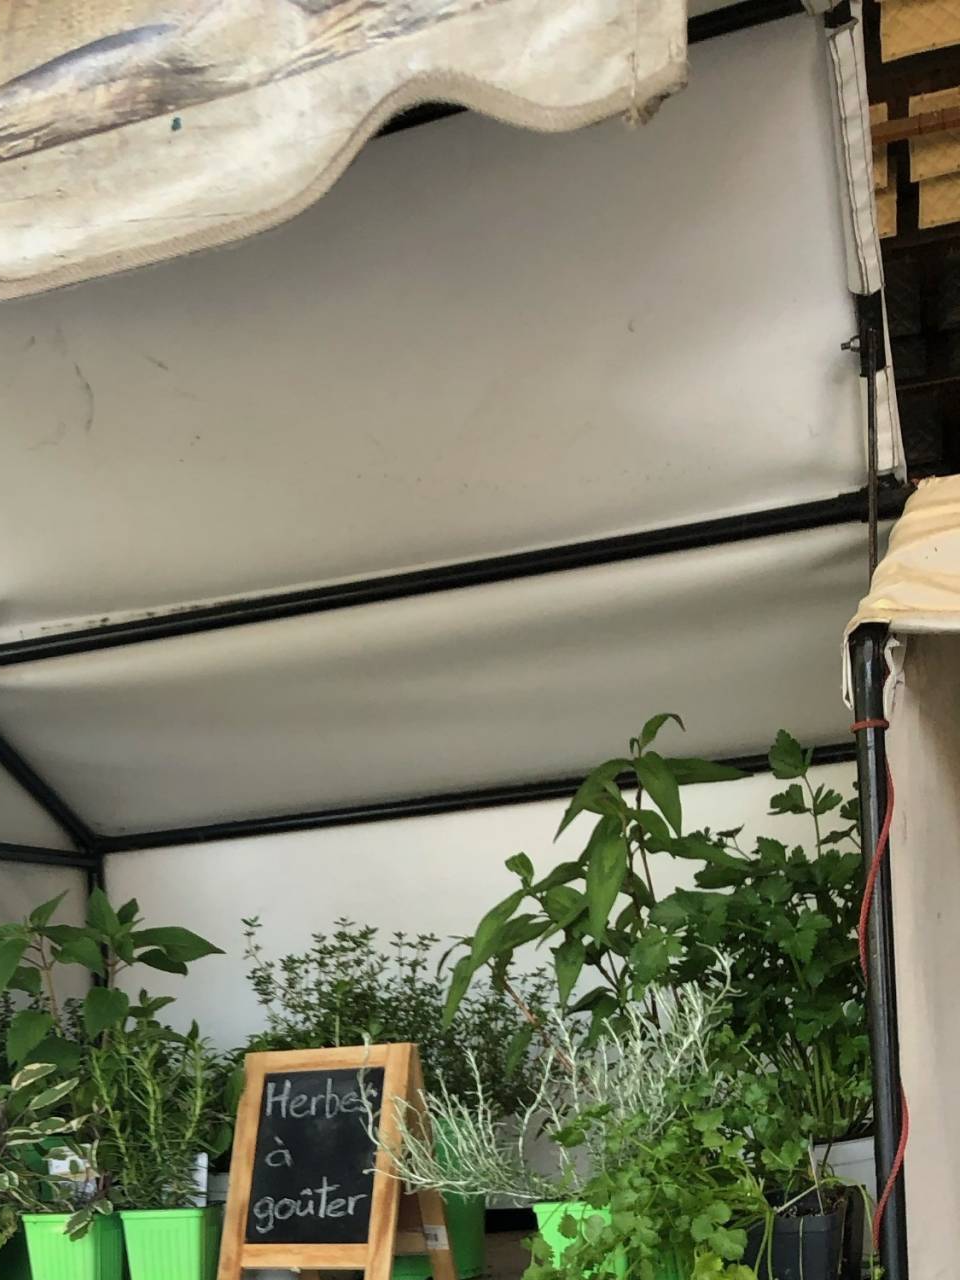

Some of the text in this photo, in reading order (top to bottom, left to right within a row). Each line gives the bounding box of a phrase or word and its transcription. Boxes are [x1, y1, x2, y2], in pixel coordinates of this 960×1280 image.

[265, 1077, 378, 1119] Herbes
[264, 1135, 293, 1167] à
[253, 1176, 368, 1234] goûter
